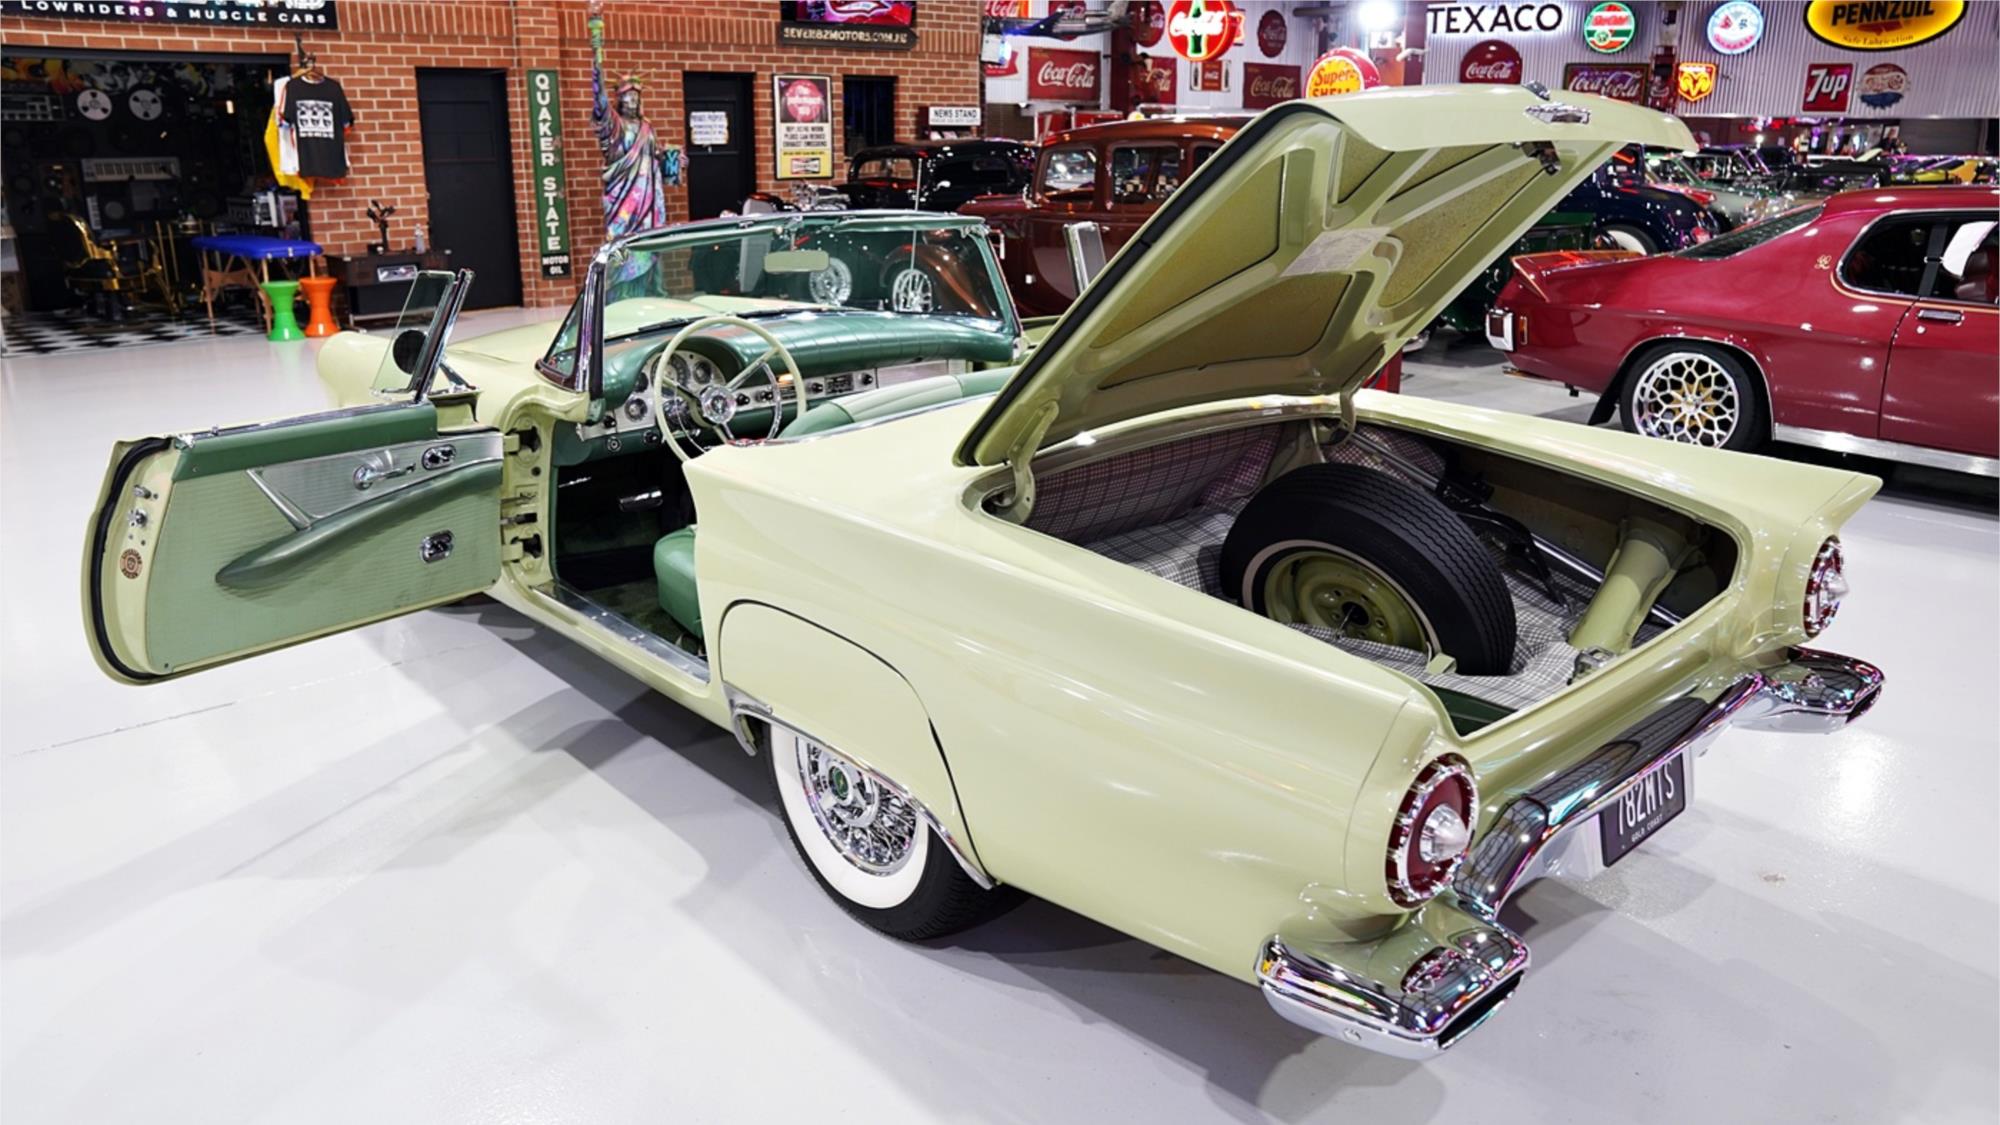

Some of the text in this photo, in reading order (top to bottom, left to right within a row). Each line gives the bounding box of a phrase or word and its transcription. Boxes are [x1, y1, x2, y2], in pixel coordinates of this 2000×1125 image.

[21, 1, 327, 24] LOWRIDERS & MUSCLE CARS
[1427, 4, 1563, 34] TEXACO
[1831, 0, 1936, 26] PENNZOIL
[1038, 61, 1095, 88] Coca-Cola
[1465, 61, 1515, 79] Coca-Cola
[934, 109, 977, 118] NEWS STAND
[535, 73, 561, 250] QUAKER STATE
[542, 255, 569, 265] MOTOR
[550, 265, 564, 275] OIL
